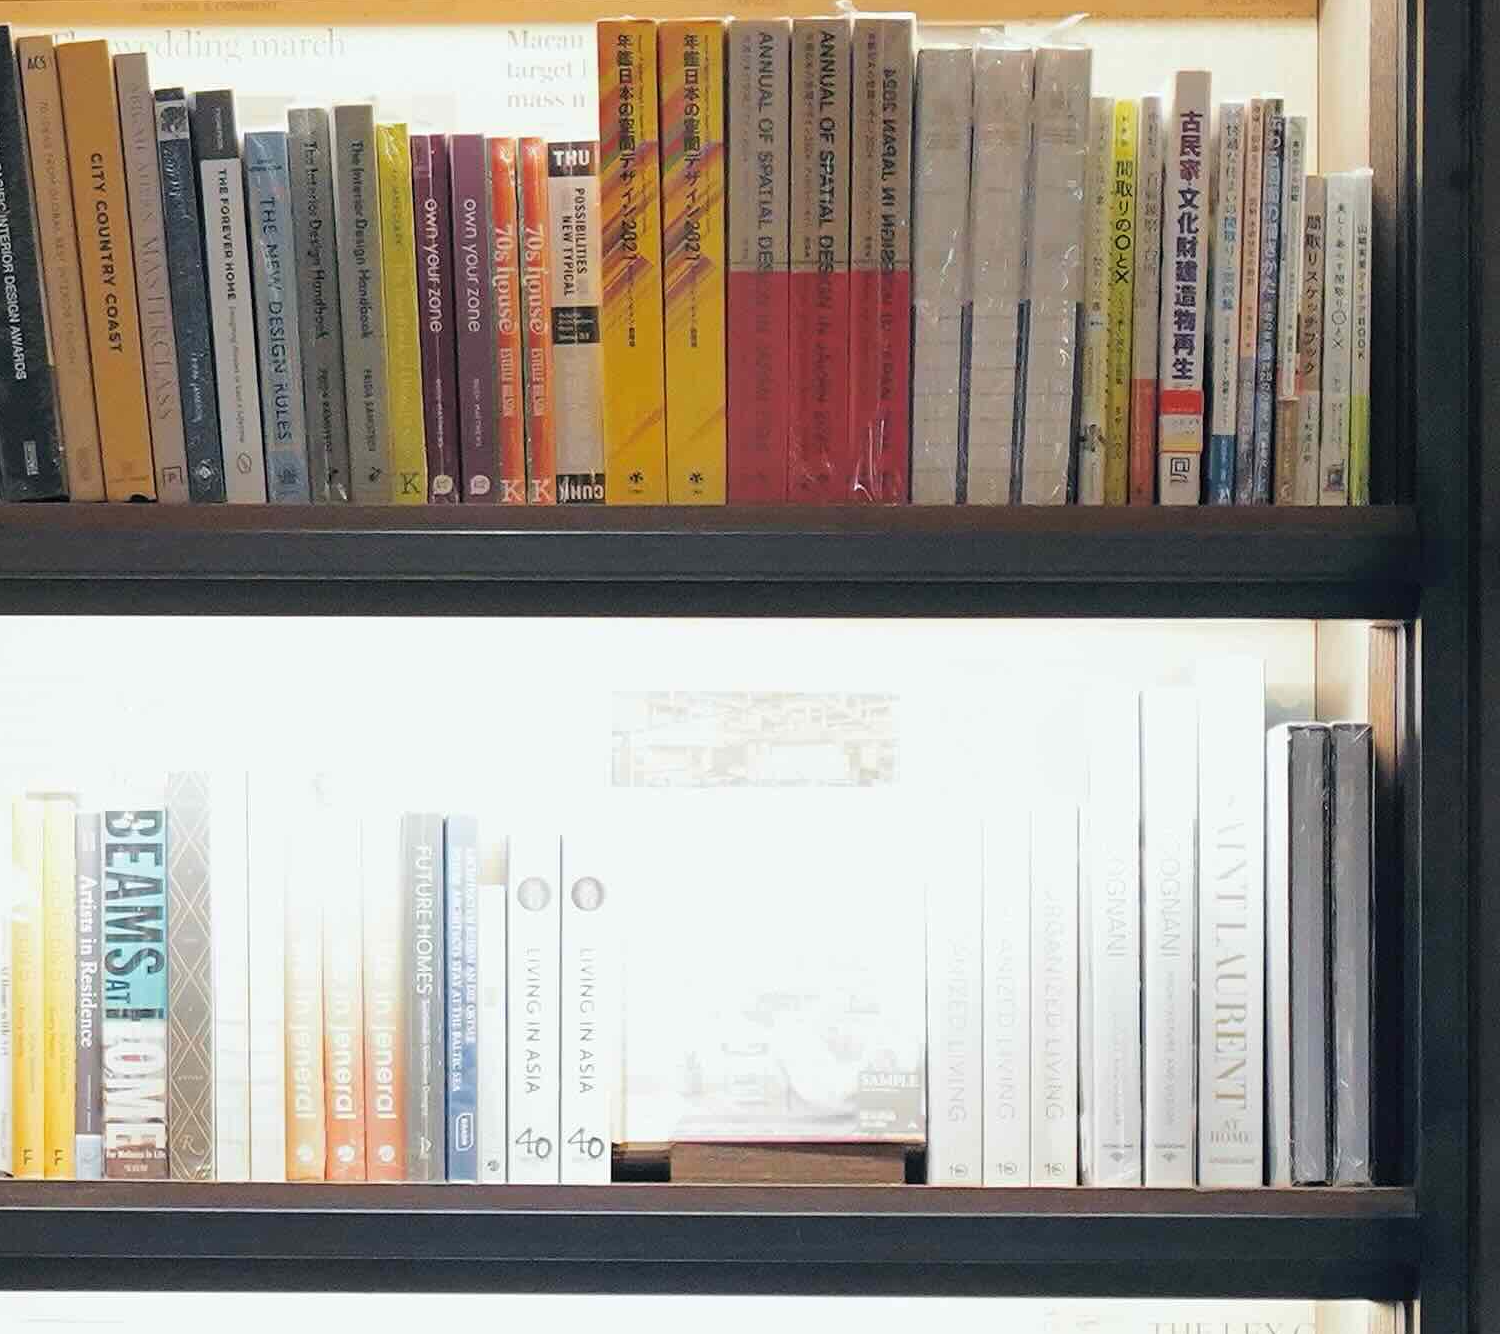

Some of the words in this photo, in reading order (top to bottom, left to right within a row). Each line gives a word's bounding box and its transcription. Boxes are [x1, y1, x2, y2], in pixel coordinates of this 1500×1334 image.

[249, 27, 346, 58] march
[819, 31, 836, 112] ANNUAL
[554, 150, 589, 167] THU
[819, 118, 835, 148] OF
[90, 153, 106, 193] CITY
[219, 169, 228, 194] THE
[818, 152, 835, 228] SPATIAL
[95, 199, 116, 286] COUNTRY
[220, 197, 234, 265] FOREVER
[261, 197, 277, 237] THE
[464, 198, 477, 240] own
[563, 215, 572, 242] NEW
[576, 188, 588, 274] POSSIBILITIES
[225, 266, 237, 300] HOME
[466, 241, 481, 288] your
[564, 245, 573, 297] TYPICAL
[4, 272, 20, 329] DESIGN
[103, 293, 124, 354] COAST
[467, 290, 481, 333] zone
[7, 328, 27, 380] AWARDS
[266, 301, 288, 375] DESIGN
[273, 383, 291, 442] RULES
[80, 874, 97, 930] Artists
[105, 810, 163, 976] BEAMS
[415, 846, 432, 917] FUTURE
[81, 936, 96, 956] in
[416, 923, 432, 995] HOMES
[80, 959, 97, 1048] Residence
[105, 978, 130, 1004] AT
[525, 947, 540, 1015] LIVING
[525, 1020, 540, 1042] IN
[525, 1049, 540, 1094] ASIA
